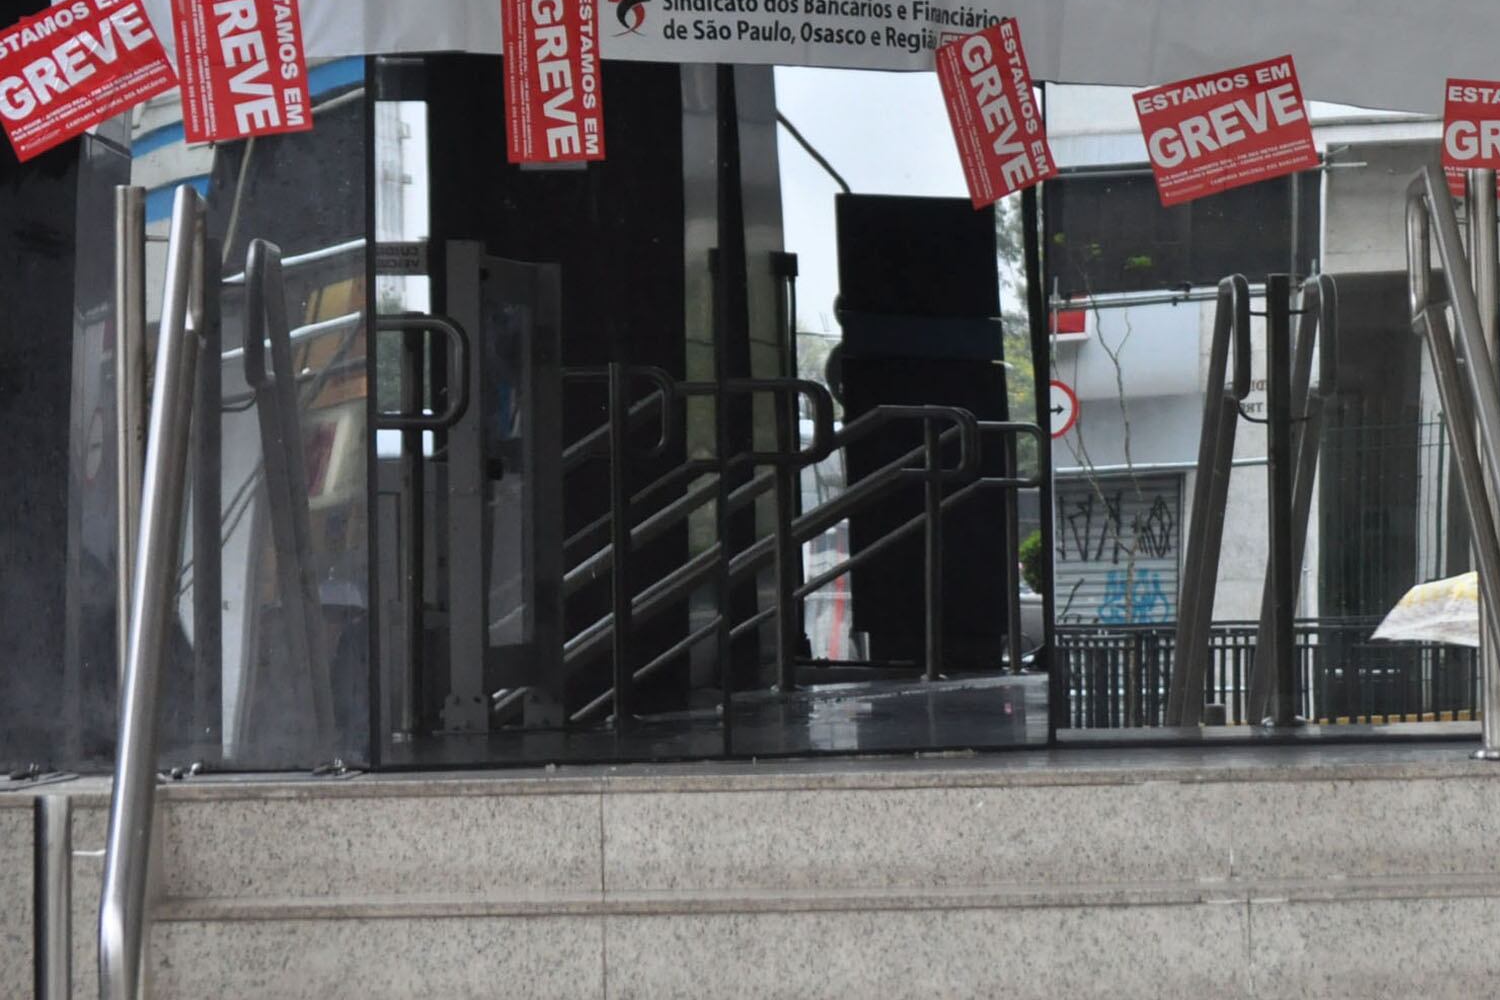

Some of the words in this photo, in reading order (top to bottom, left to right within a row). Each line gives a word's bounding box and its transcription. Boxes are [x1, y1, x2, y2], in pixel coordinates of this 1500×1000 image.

[663, 20, 688, 40] de
[694, 20, 732, 41] São
[737, 21, 796, 44] Paulo,
[800, 29, 866, 46] Osasco
[871, 31, 881, 46] e
[897, 5, 906, 20] e
[912, 0, 1009, 30] Financiário
[0, 3, 154, 120] GREVE
[283, 87, 304, 126] EM
[962, 35, 1034, 191] GREVE
[1001, 22, 1038, 135] ESTAMOS
[1031, 140, 1050, 175] EM
[1138, 74, 1249, 114] ESTAMOS
[1256, 62, 1291, 84] EM
[584, 118, 599, 155] EM
[1149, 83, 1304, 168] GREVE
